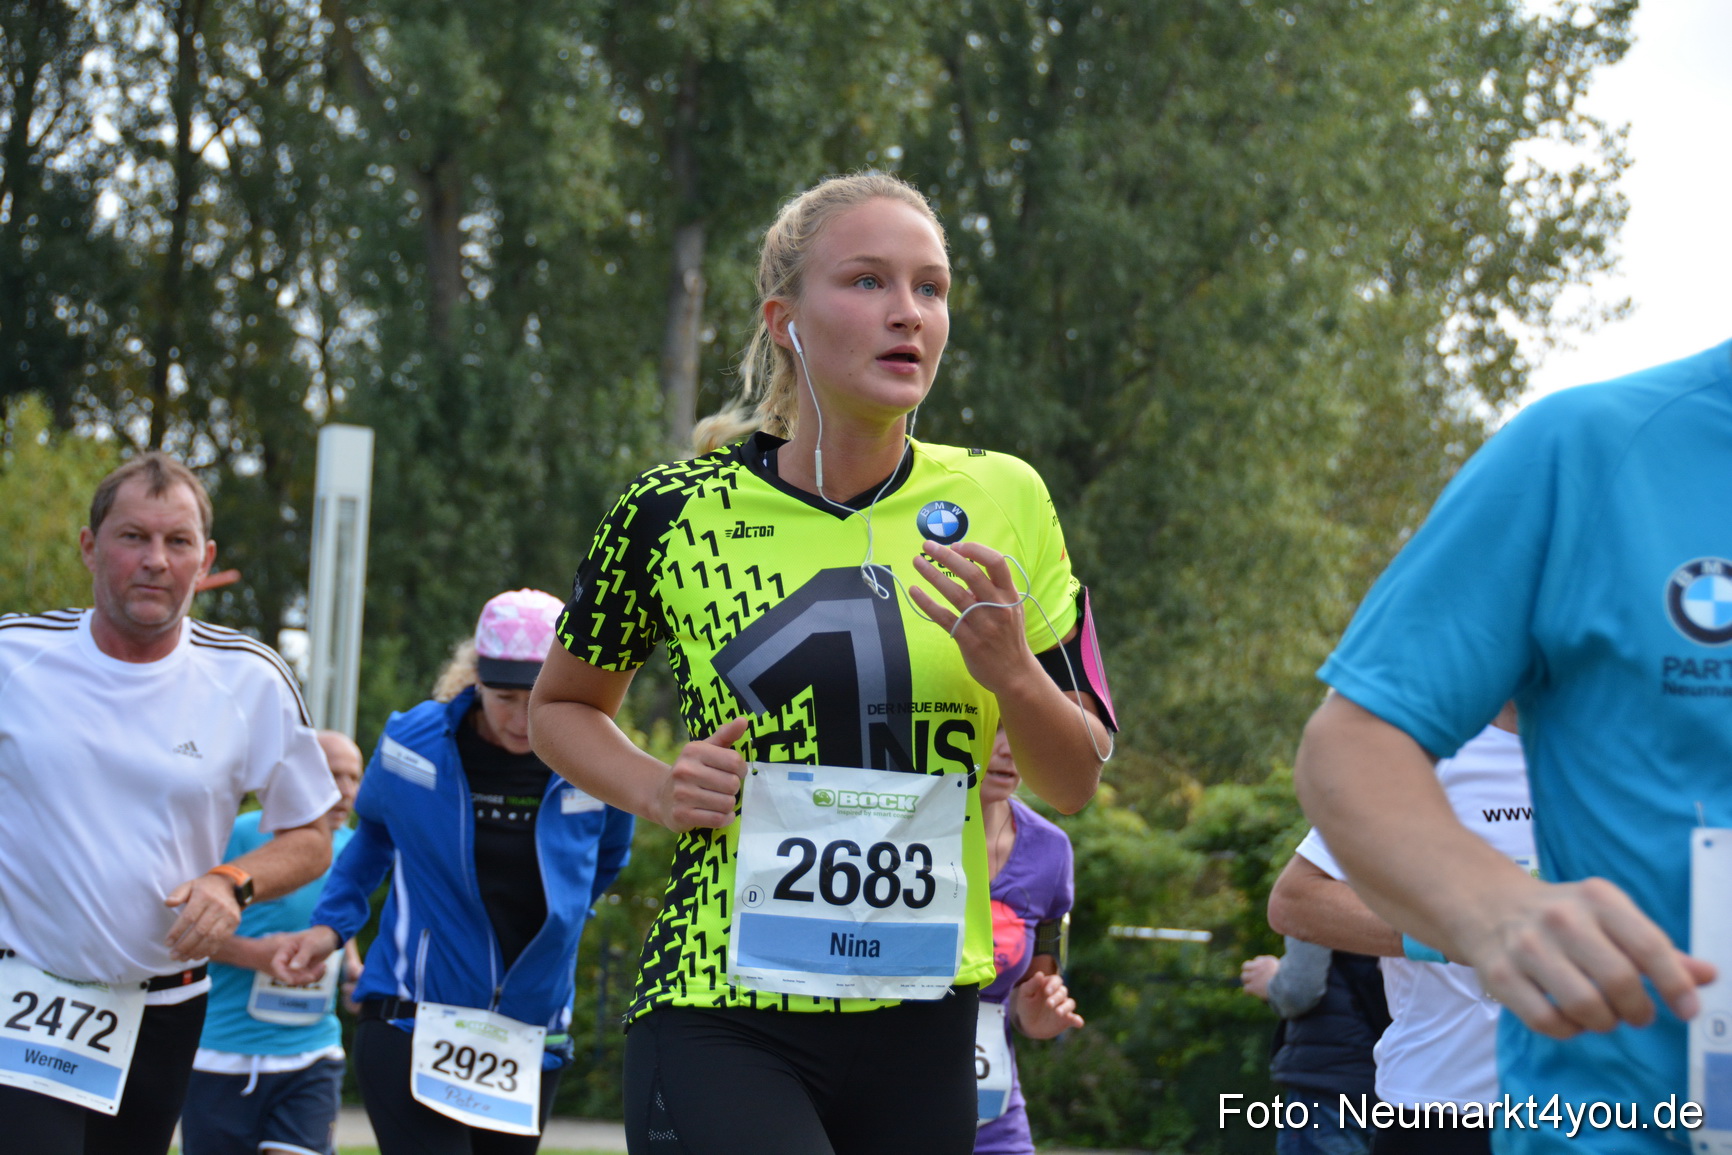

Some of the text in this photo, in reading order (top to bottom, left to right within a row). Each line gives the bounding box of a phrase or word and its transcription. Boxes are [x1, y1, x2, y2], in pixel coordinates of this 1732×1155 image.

[920, 502, 962, 517] BMW
[867, 704, 894, 715] DER
[898, 702, 932, 713] NEUE
[934, 702, 963, 714] BMW
[837, 790, 919, 812] BOCK
[864, 809, 872, 817] by
[772, 837, 936, 909] 2683
[748, 891, 757, 903] D
[830, 932, 881, 958] Nina
[5, 991, 118, 1053] 2472
[24, 1048, 78, 1075] Werner
[432, 1040, 518, 1092] 2923
